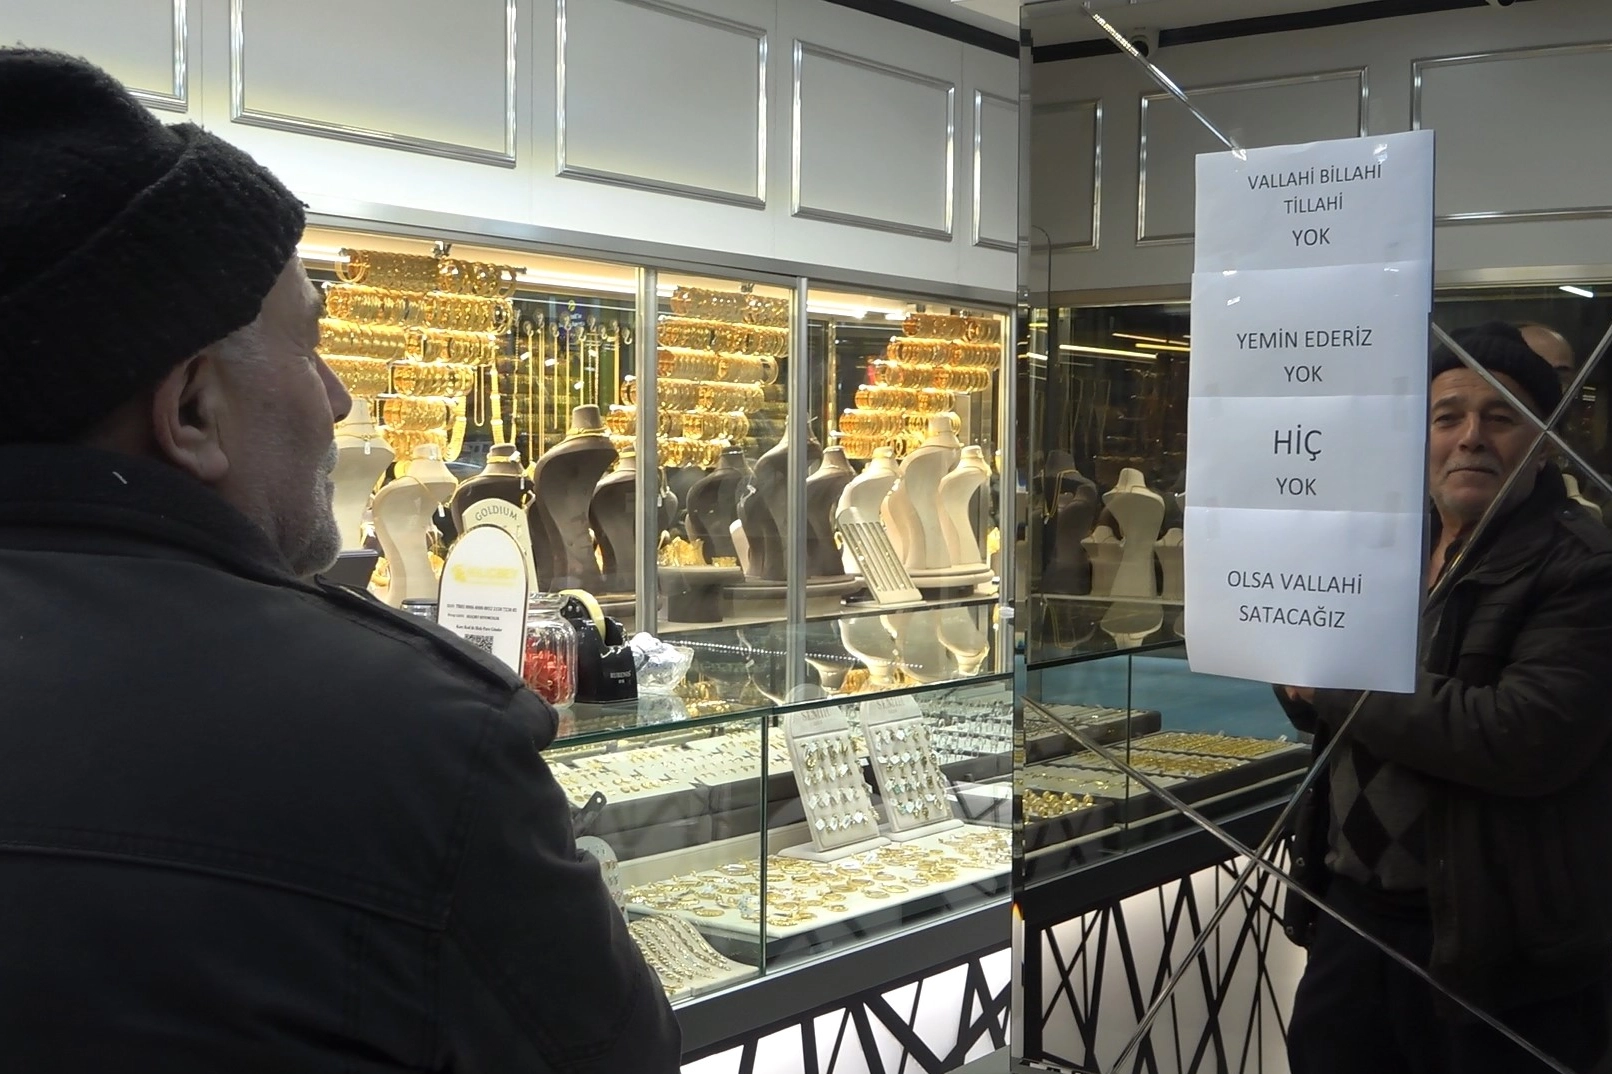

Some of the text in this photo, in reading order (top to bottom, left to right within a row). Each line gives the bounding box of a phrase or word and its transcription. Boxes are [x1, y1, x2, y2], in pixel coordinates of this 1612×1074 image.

[1247, 162, 1382, 191] VALLAHİ BİLLAHİ
[1283, 192, 1343, 215] TİLLAHİ
[1292, 227, 1331, 247] YOK
[1236, 325, 1373, 350] YEMİN EDERİZ
[1283, 365, 1323, 383] YOK
[1273, 424, 1323, 462] HİÇ
[1276, 477, 1317, 496] YOK
[474, 504, 518, 522] GOLDIUM
[1227, 570, 1363, 595] OLSA VALLAHİ
[1238, 604, 1346, 629] SATACAĞIZ
